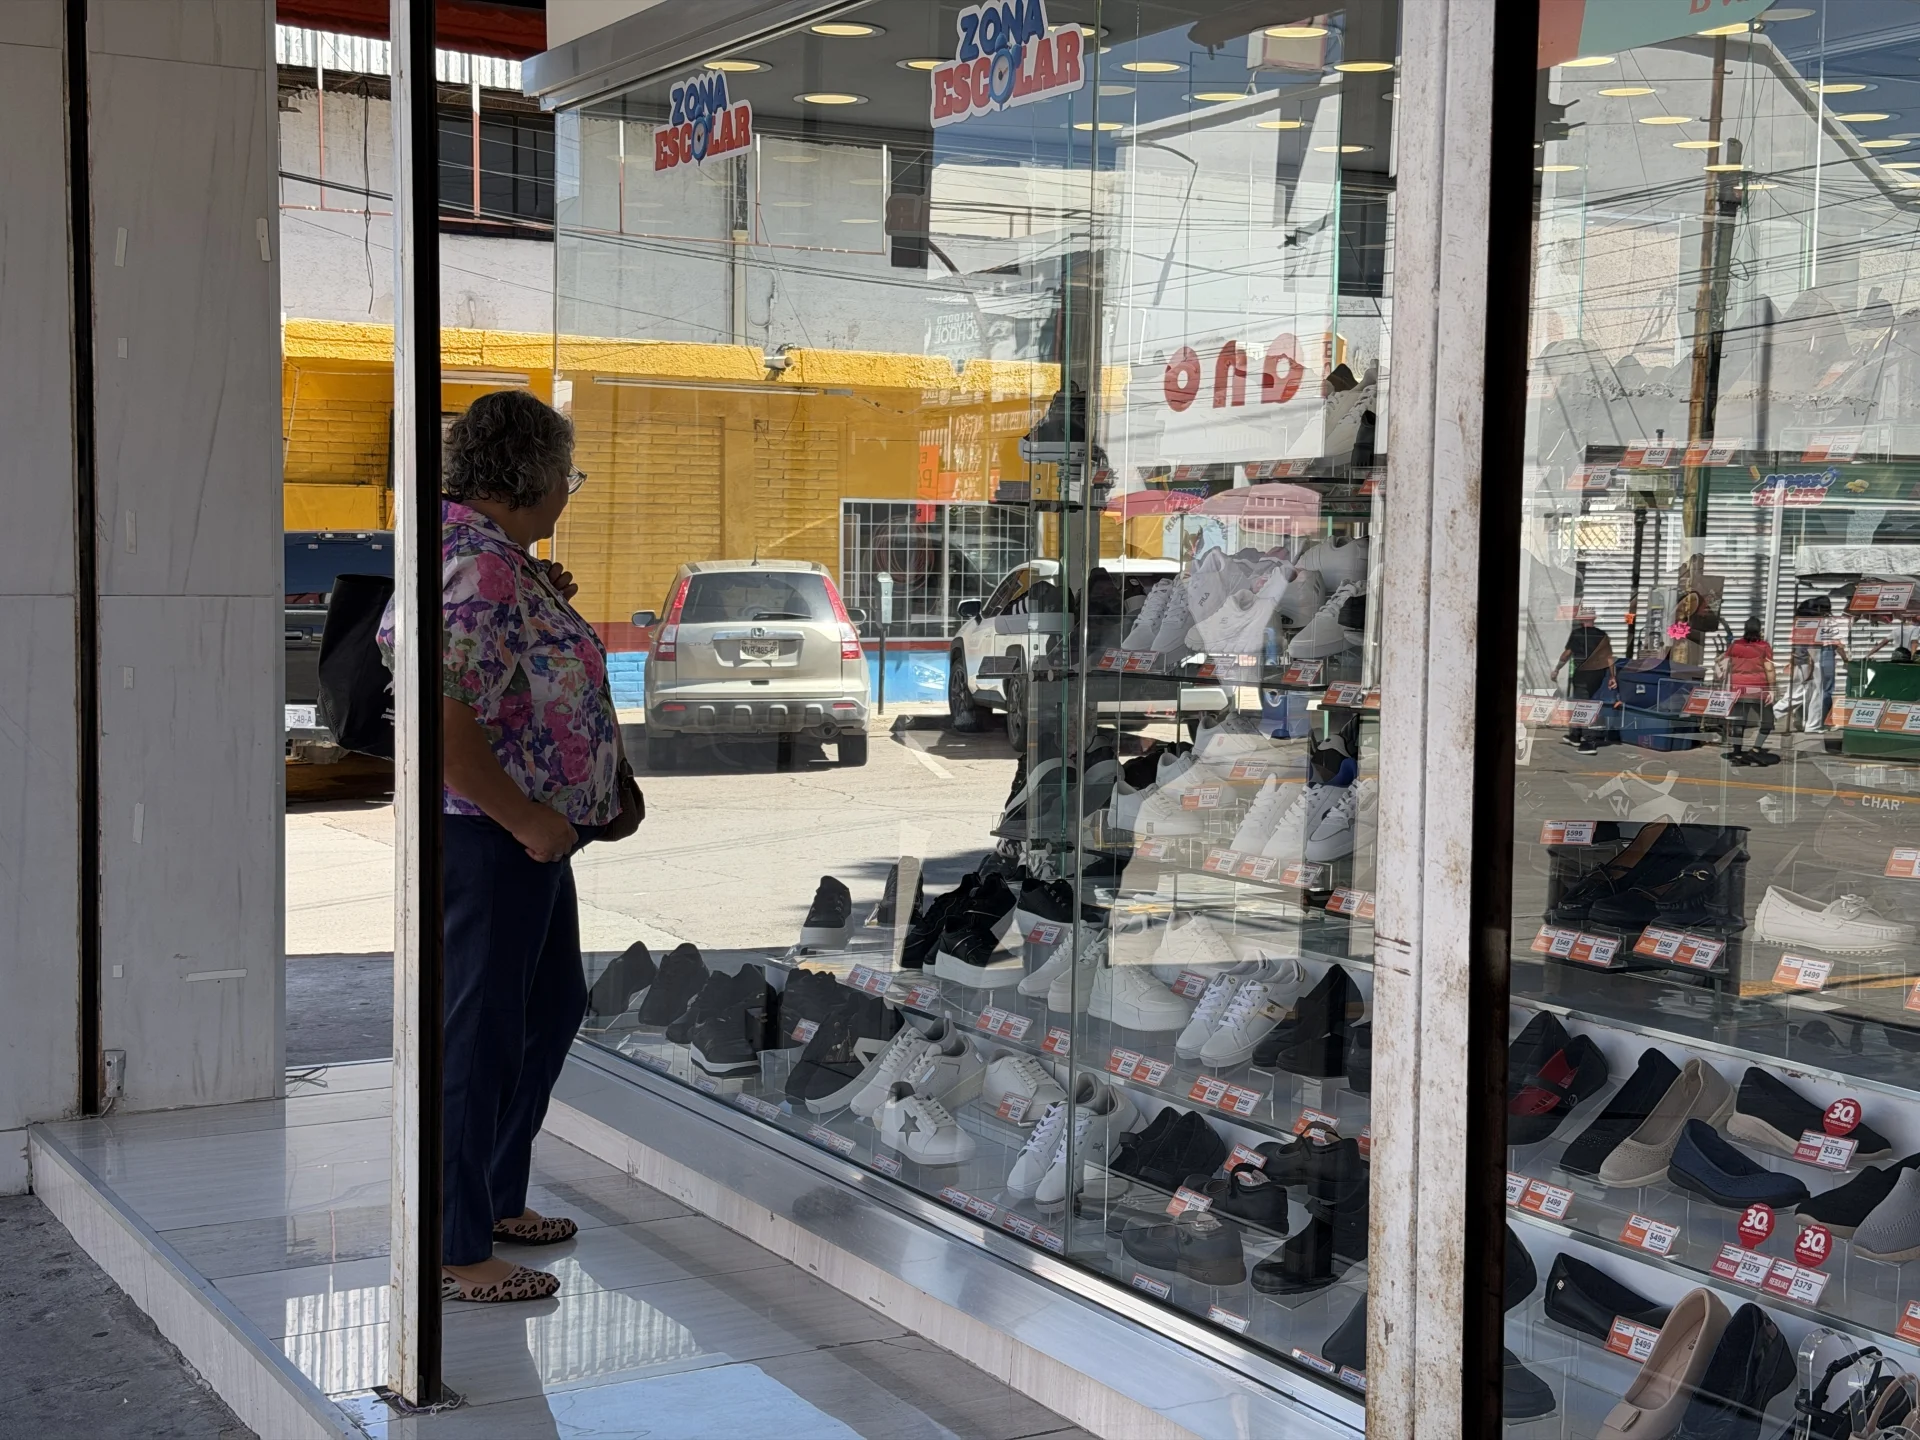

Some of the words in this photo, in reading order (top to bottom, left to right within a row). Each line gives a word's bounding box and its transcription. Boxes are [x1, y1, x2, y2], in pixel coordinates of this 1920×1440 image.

[960, 0, 1044, 62] ZONA
[934, 31, 1080, 119] ESCOLAR
[672, 74, 727, 127] ZONA
[655, 106, 750, 171] ESCOLAR
[1648, 449, 1665, 457] $649
[1832, 444, 1849, 452] $649
[1199, 592, 1210, 607] FILA
[1856, 709, 1875, 717] $449
[1566, 830, 1583, 838] $599
[1556, 939, 1569, 947] $549
[1658, 940, 1672, 948] $549
[1594, 947, 1609, 955] $549
[1695, 950, 1709, 959] $549
[1802, 970, 1820, 979] $499
[1824, 1146, 1842, 1156] $379
[1546, 1196, 1561, 1207] $499
[1650, 1232, 1666, 1243] $499
[1716, 1260, 1737, 1272] REBAJAS
[1742, 1262, 1760, 1273] $379
[1768, 1277, 1789, 1289] REBAJAS
[1794, 1279, 1812, 1290] $379
[1634, 1338, 1651, 1350] $499
